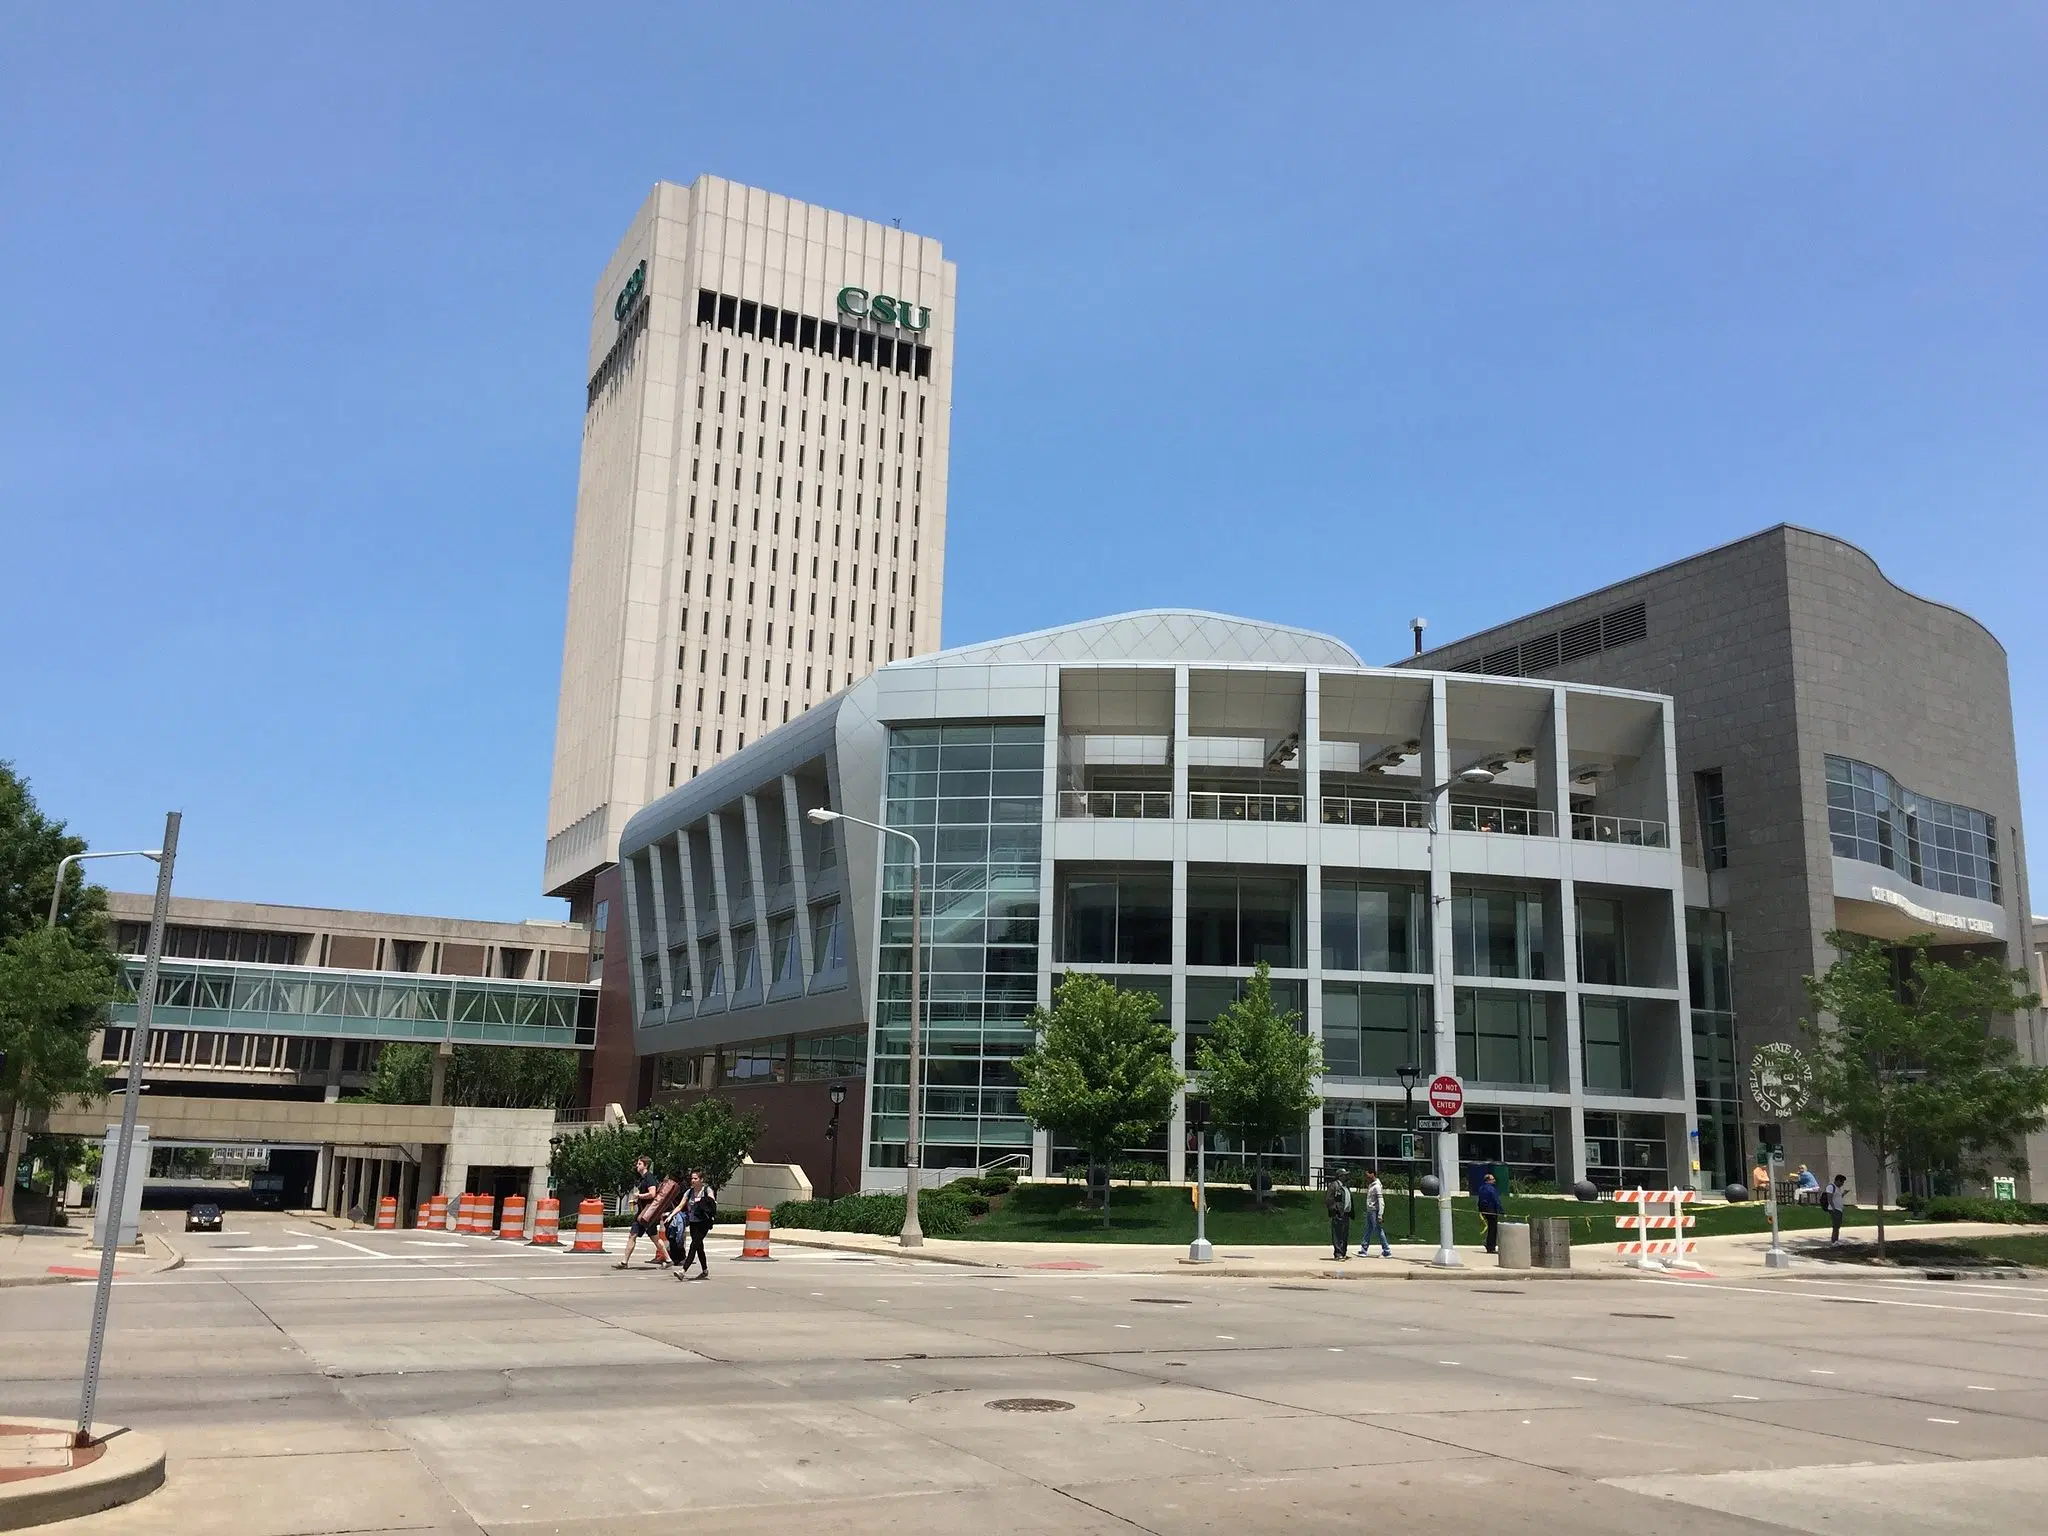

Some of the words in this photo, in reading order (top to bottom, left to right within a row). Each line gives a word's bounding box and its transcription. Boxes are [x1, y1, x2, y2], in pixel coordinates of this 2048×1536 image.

[837, 287, 931, 331] CSU
[1445, 1084, 1457, 1092] NOT
[1436, 1101, 1456, 1109] ENTER
[1775, 1107, 1792, 1119] 1964
